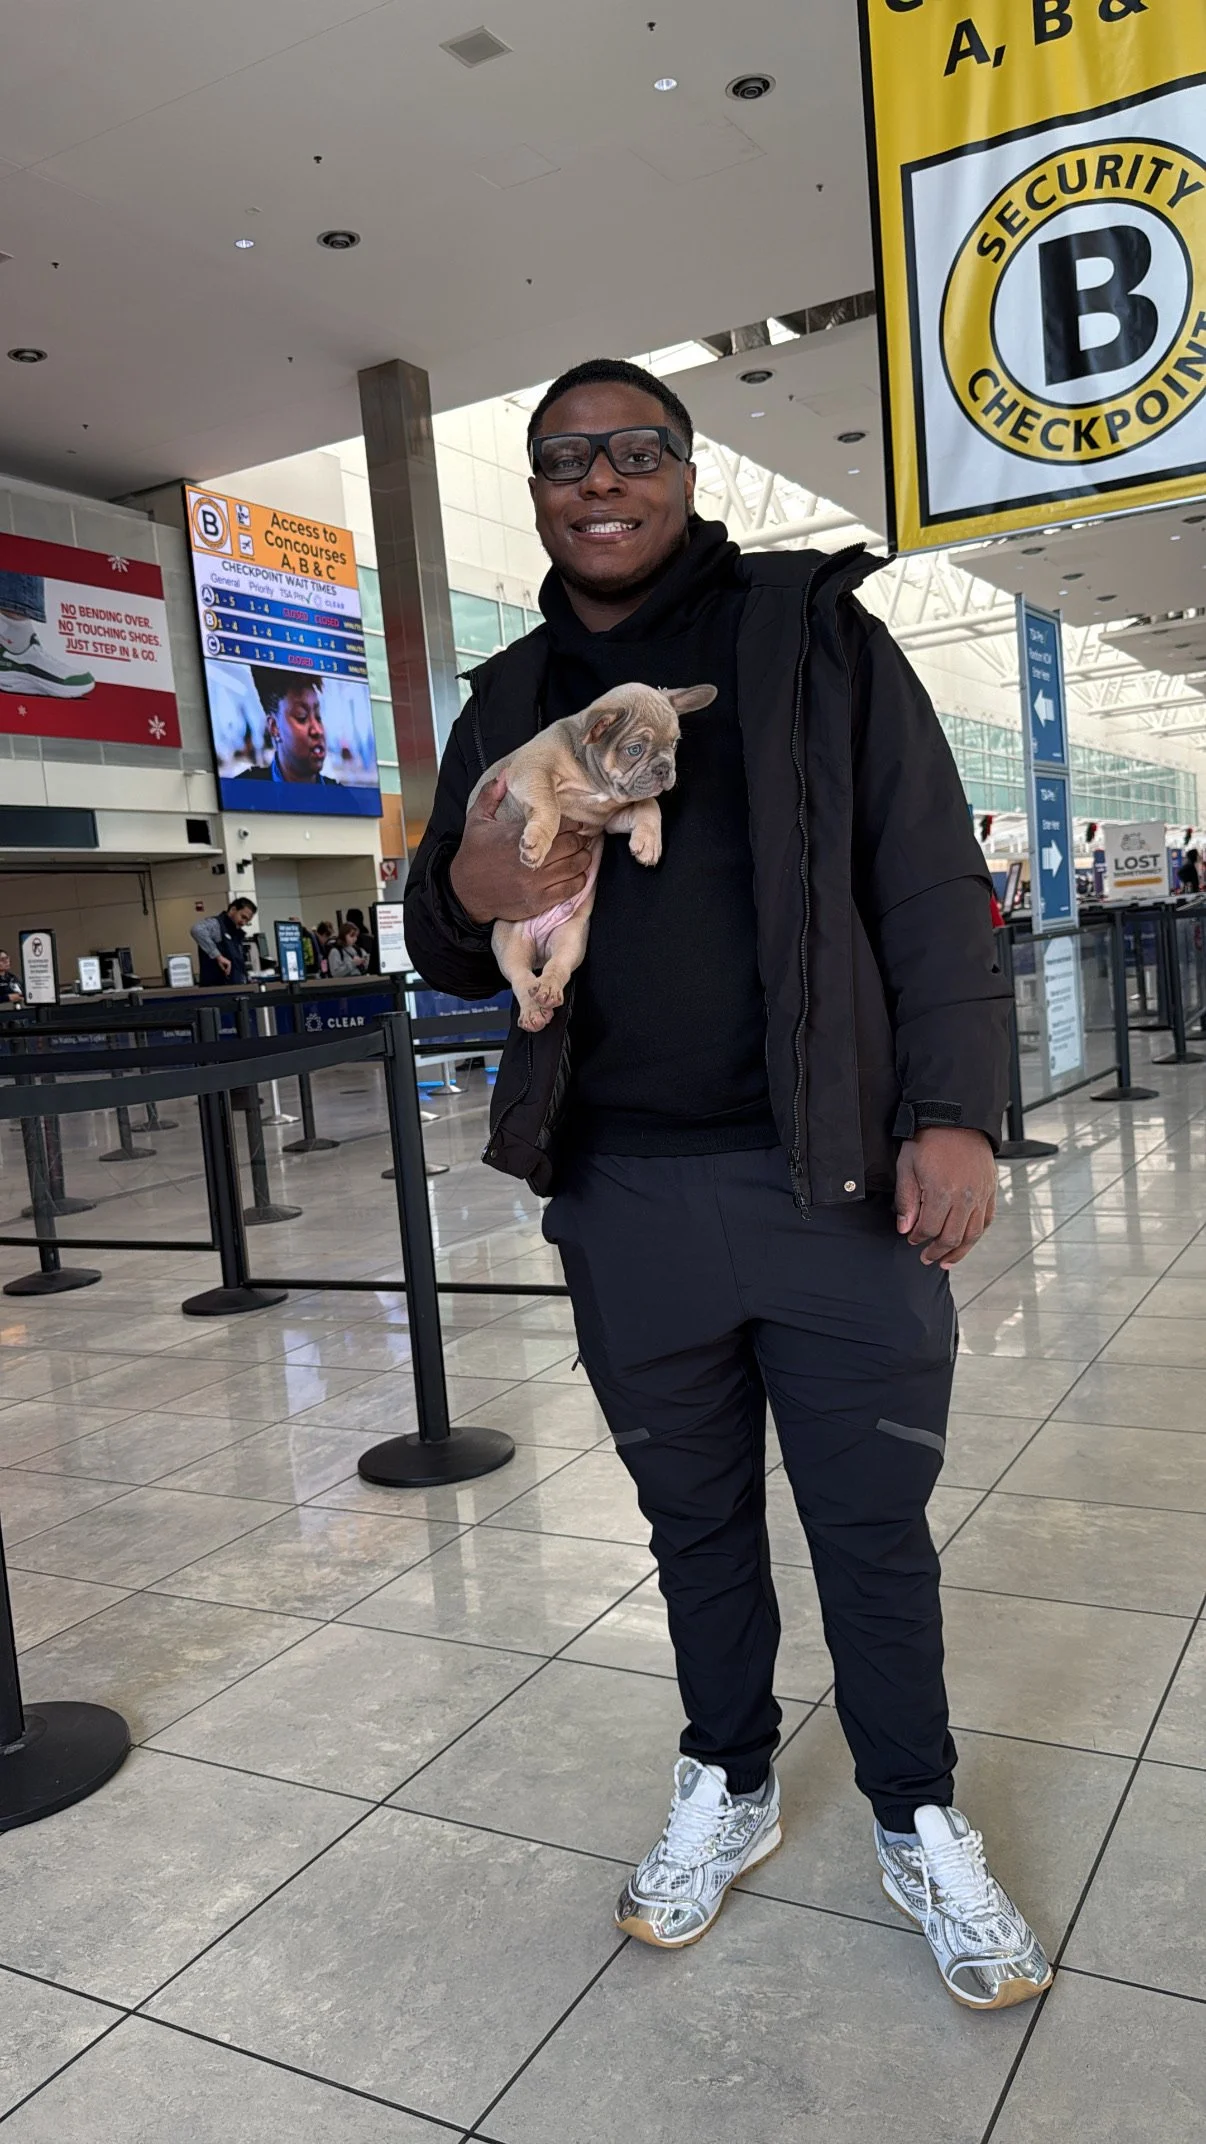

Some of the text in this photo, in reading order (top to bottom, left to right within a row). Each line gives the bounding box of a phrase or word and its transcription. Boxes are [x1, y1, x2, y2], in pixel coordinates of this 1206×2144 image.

[943, 17, 1006, 77] A,
[1032, 0, 1072, 46] B
[977, 153, 1205, 263] SECURITY
[1038, 225, 1158, 387] B
[201, 509, 219, 536] B
[271, 512, 337, 544] Access to
[264, 530, 347, 565] Concourses
[222, 560, 337, 596] CHECKPOINT WAIT TIMES
[281, 553, 336, 580] A, B & C
[210, 573, 240, 588] General
[249, 582, 274, 597] Priority
[61, 602, 153, 629] NO BENDING OVER.
[58, 619, 162, 647] NO TOUCHING SHOES.
[66, 638, 89, 651] JUST
[92, 641, 117, 655] STEP
[119, 646, 130, 657] IN
[132, 647, 139, 659] &
[1114, 854, 1161, 871] LOST
[327, 1016, 365, 1028] CLEAR
